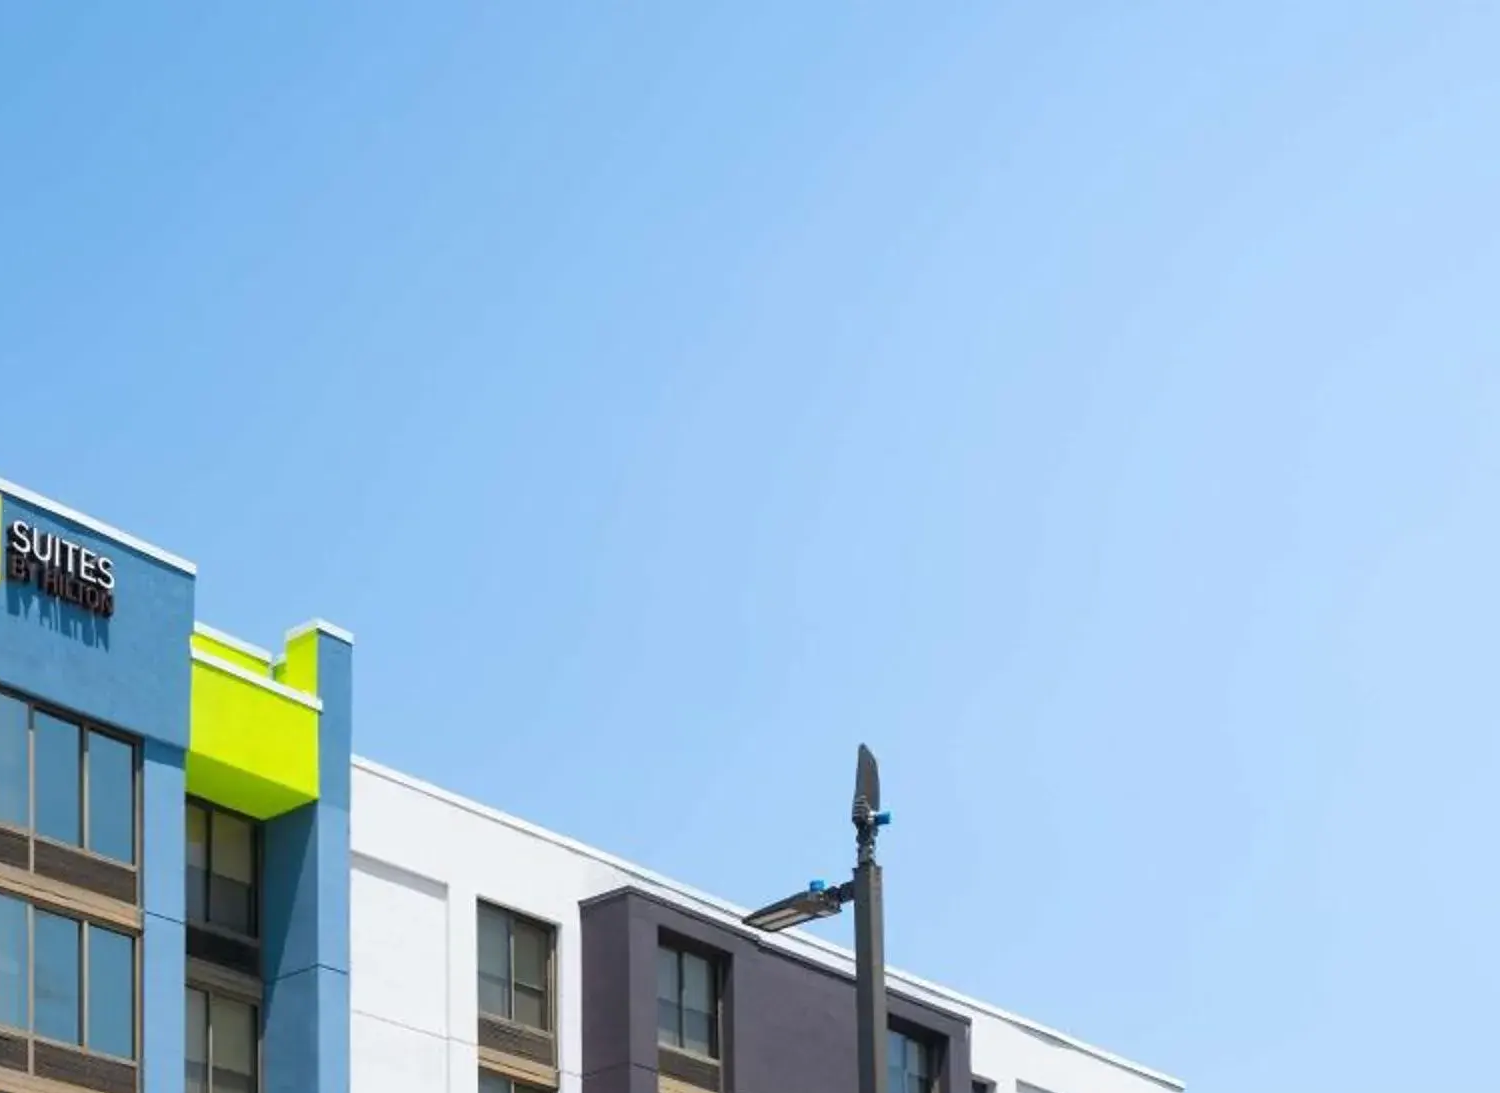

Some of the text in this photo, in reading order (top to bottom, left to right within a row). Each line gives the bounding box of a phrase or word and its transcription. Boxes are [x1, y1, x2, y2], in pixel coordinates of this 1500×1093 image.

[10, 554, 115, 616] BY HILTON
[11, 520, 115, 589] SUITES
